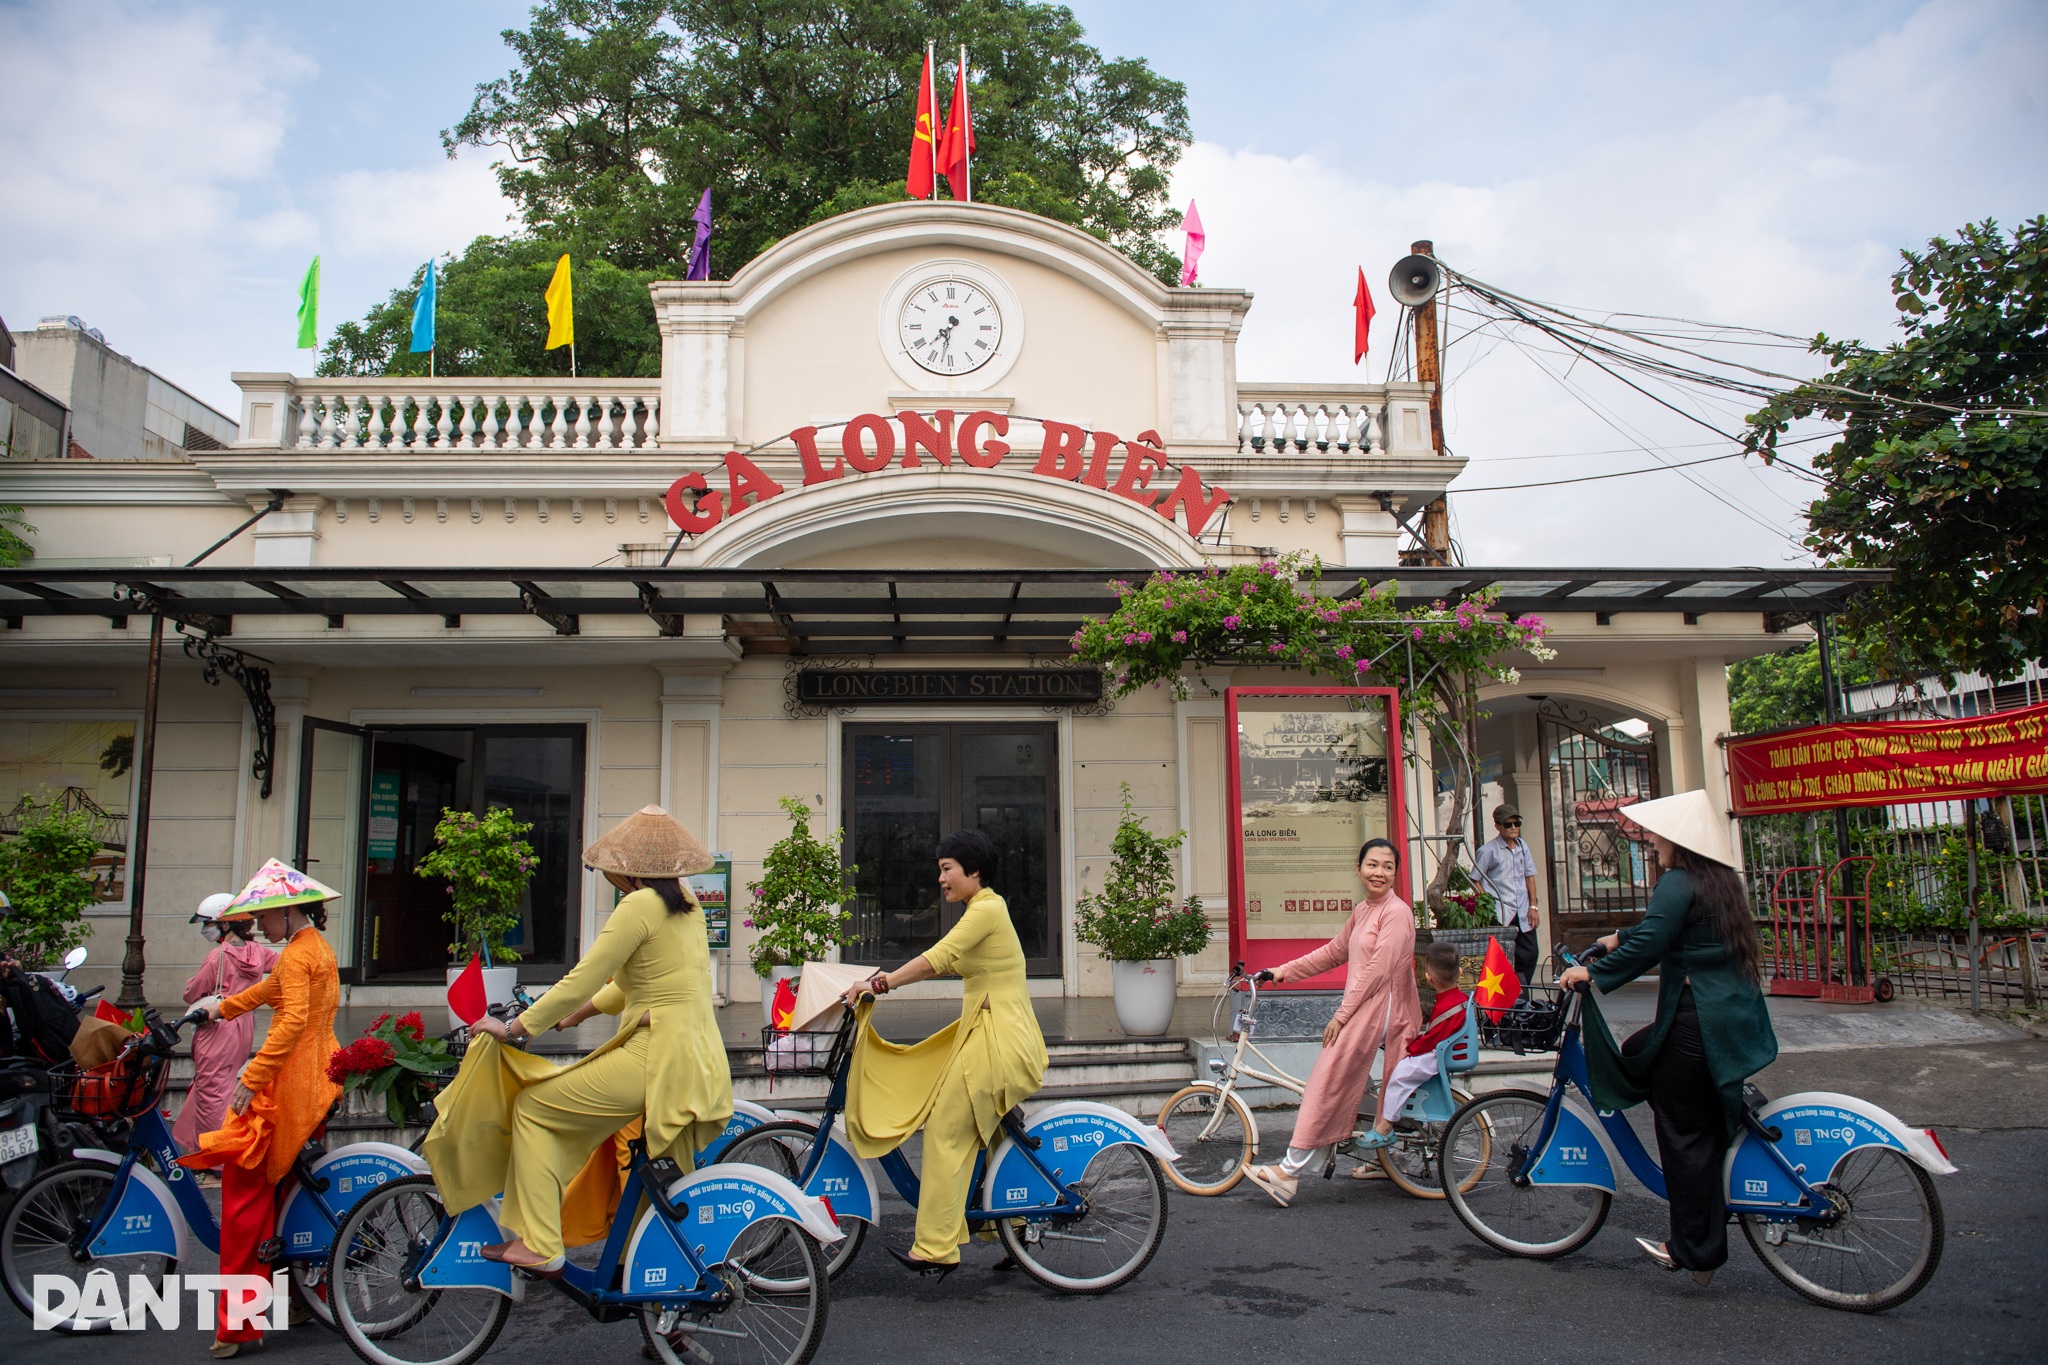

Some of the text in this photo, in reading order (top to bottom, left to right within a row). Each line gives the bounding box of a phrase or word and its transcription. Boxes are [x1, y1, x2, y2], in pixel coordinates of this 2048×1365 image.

[665, 409, 1230, 538] GA LONG BIÊN
[970, 674, 1084, 696] STATION
[1282, 735, 1295, 743] GA
[1297, 735, 1322, 743] LONG
[1769, 746, 1791, 768] TOÀN
[1792, 743, 1810, 765] DÂN
[1812, 740, 1832, 762] TÍCH
[1834, 738, 1854, 764] CỰC
[1855, 736, 1887, 758] THAM
[1889, 736, 1910, 755] GIA
[1909, 732, 1937, 753] GIAO
[1965, 724, 1986, 746] VŨ
[1744, 780, 1755, 802] VÀ
[1756, 779, 1776, 801] CÔNG
[1777, 780, 1789, 802] CỤ
[1825, 770, 1851, 795] CHÀO
[1853, 768, 1886, 792] MỪNG
[1903, 763, 1935, 791] NIỆM
[1934, 765, 1953, 785] 70
[1953, 758, 1984, 784] NĂM
[1986, 754, 2023, 782] NGÀY
[1279, 828, 1296, 836] BIÊN
[1782, 1111, 1795, 1121] Môi
[1838, 1111, 1855, 1123] Cuộc
[1856, 1118, 1873, 1132] sống
[0, 1128, 28, 1148] 9-E3
[1560, 1147, 1587, 1160] TN
[688, 1187, 701, 1198] Môi
[701, 1183, 722, 1194] trường
[741, 1183, 756, 1195] Cuộc
[757, 1189, 772, 1203] sống
[822, 1177, 849, 1191] TN
[124, 1215, 152, 1230] TN
